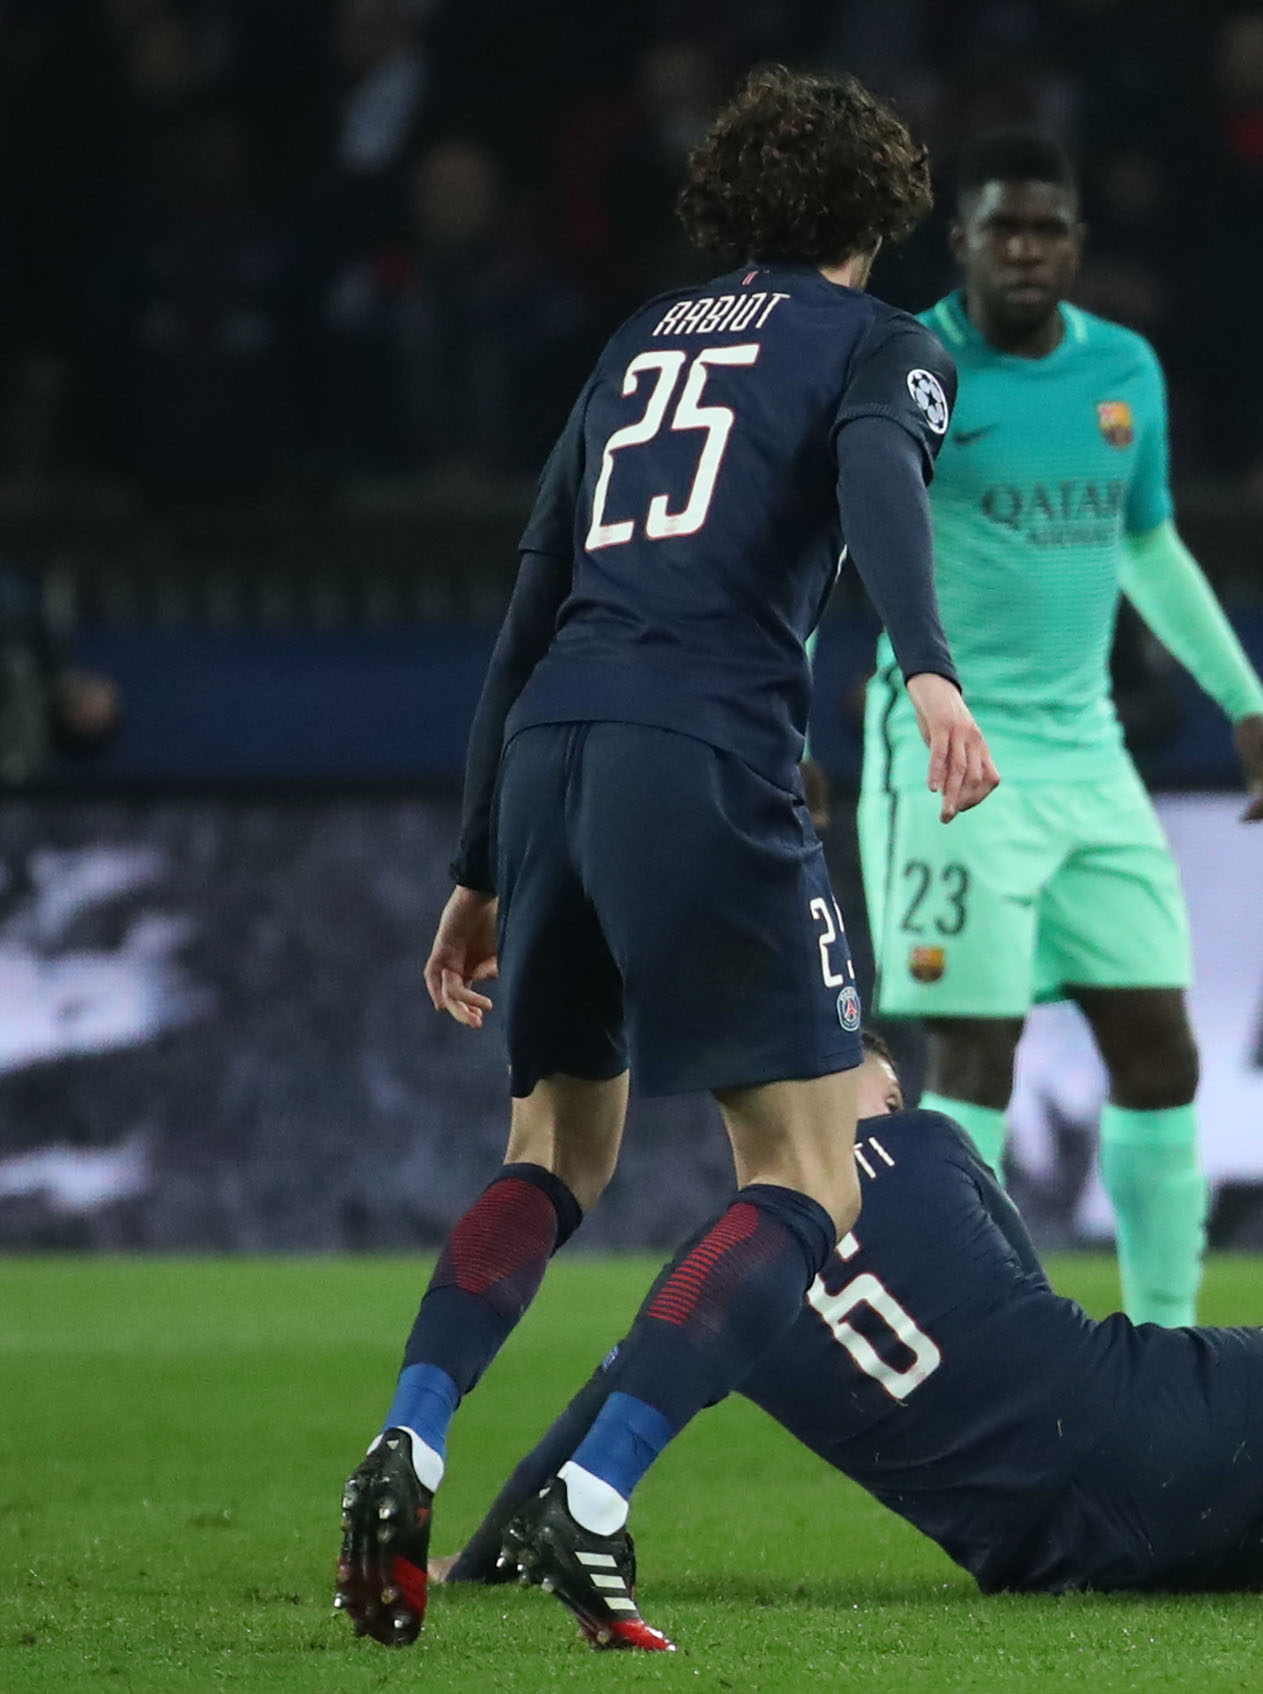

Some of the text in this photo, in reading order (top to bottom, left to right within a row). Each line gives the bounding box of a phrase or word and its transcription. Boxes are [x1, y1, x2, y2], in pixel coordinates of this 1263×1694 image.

[652, 292, 790, 336] RABIOT
[584, 343, 760, 551] 25
[810, 895, 855, 988] 2
[902, 860, 970, 936] 23
[806, 1232, 941, 1400] 6
